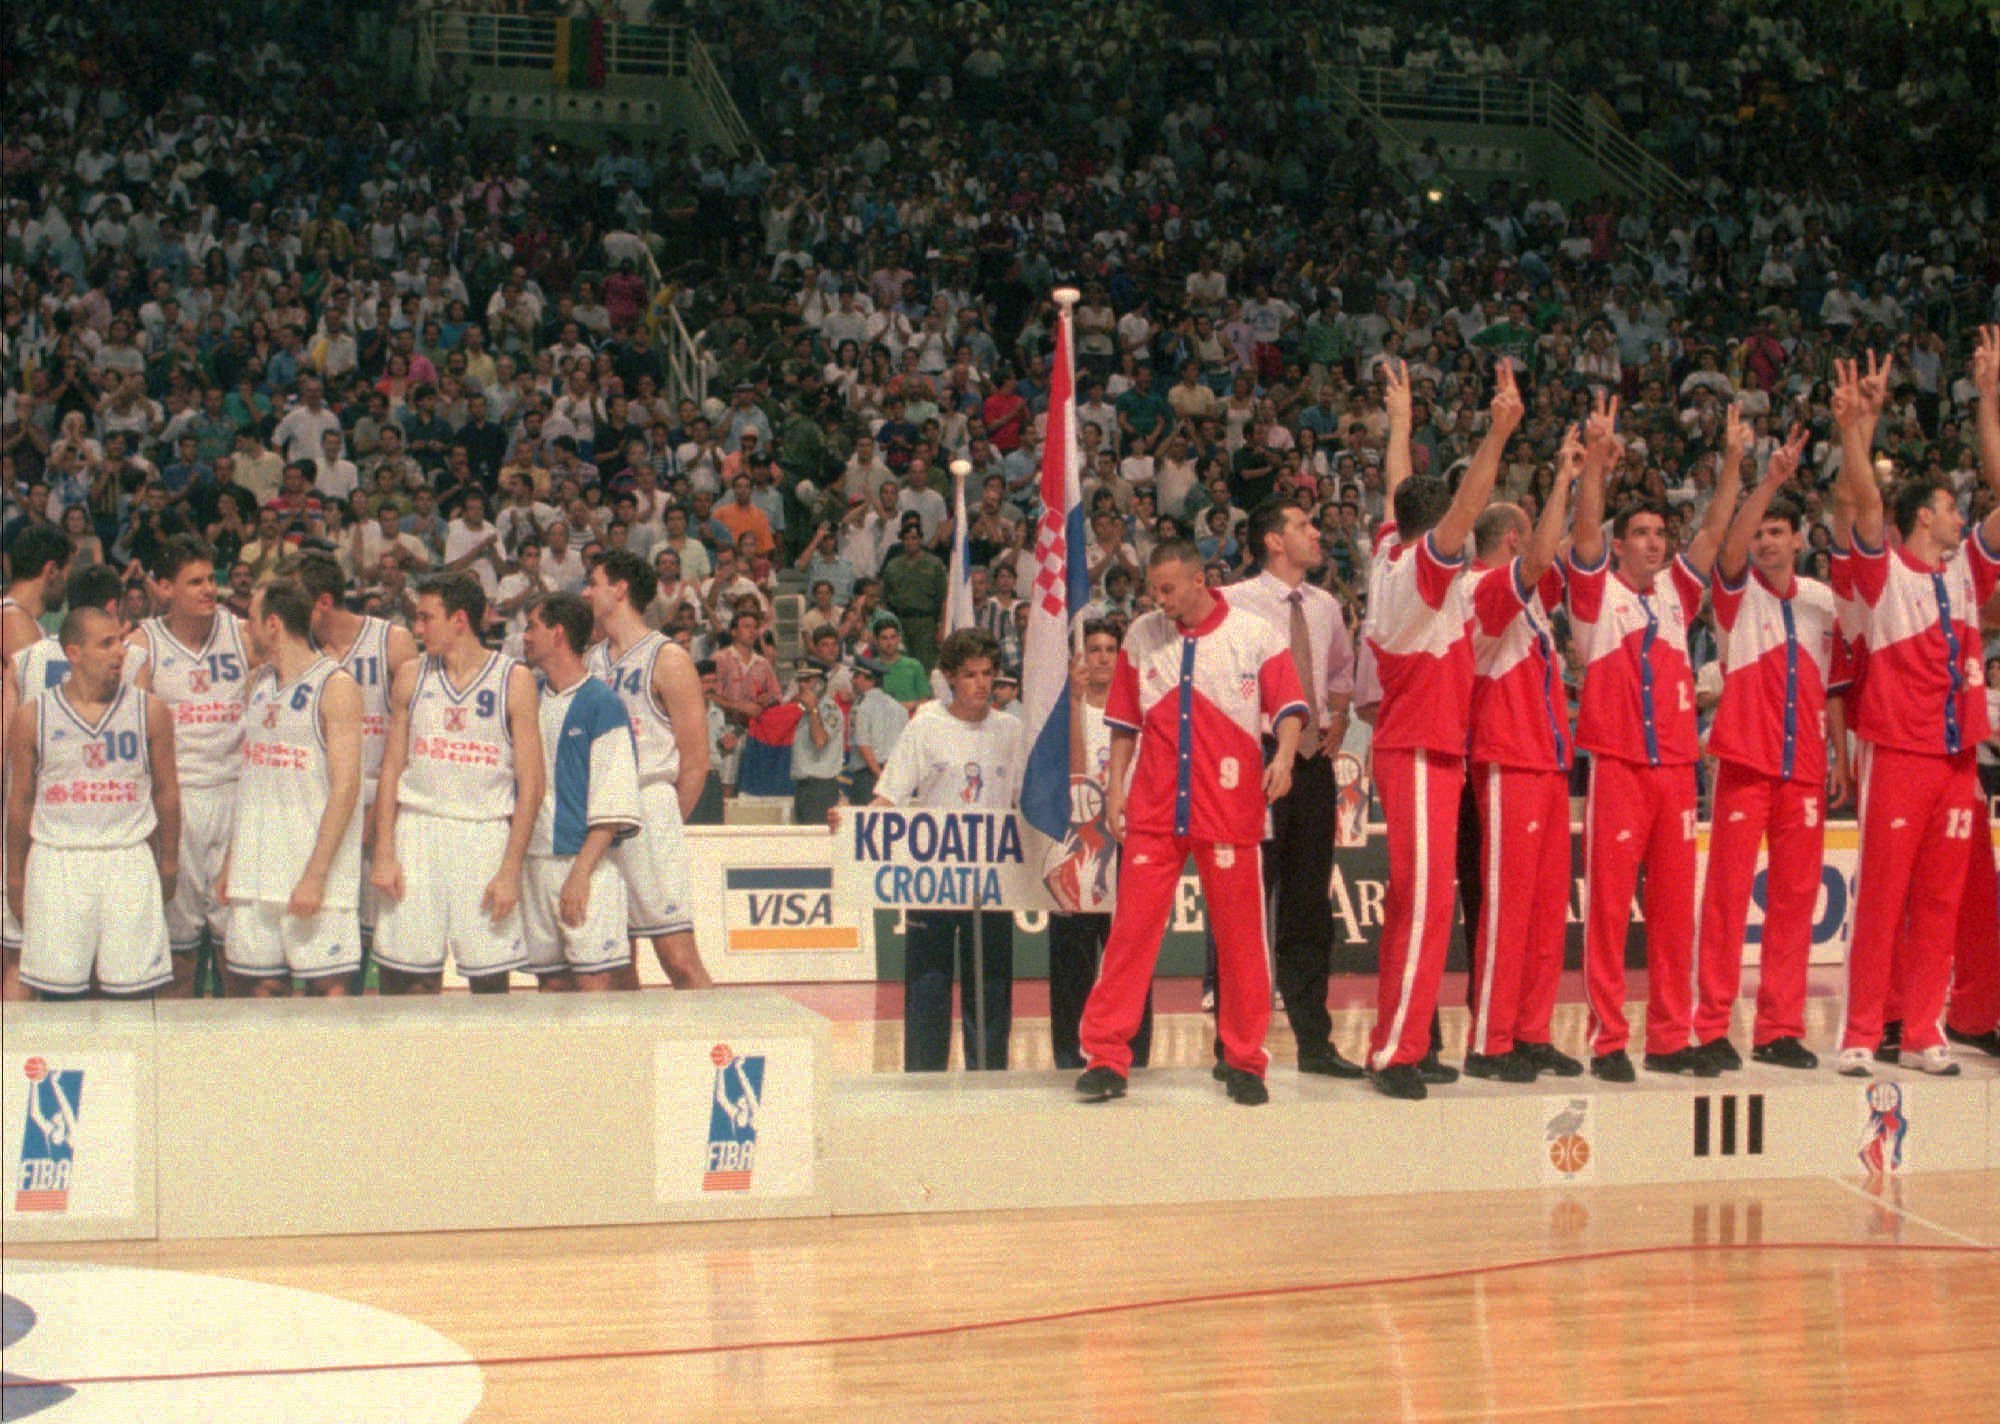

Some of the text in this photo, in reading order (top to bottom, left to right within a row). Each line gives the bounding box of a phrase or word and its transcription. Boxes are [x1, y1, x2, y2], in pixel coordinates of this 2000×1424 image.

[207, 653, 240, 682] 15
[354, 656, 377, 685] 11
[614, 667, 642, 695] 14
[290, 683, 313, 711] 6
[476, 689, 495, 718] 9
[103, 728, 137, 761] 10
[1219, 757, 1239, 790] 9
[1803, 797, 1818, 828] 5
[1946, 808, 1972, 839] 13
[875, 865, 1002, 905] CROATIA
[748, 893, 832, 925] VISA
[706, 1140, 755, 1172] FIBA
[18, 1157, 72, 1191] FIBA
